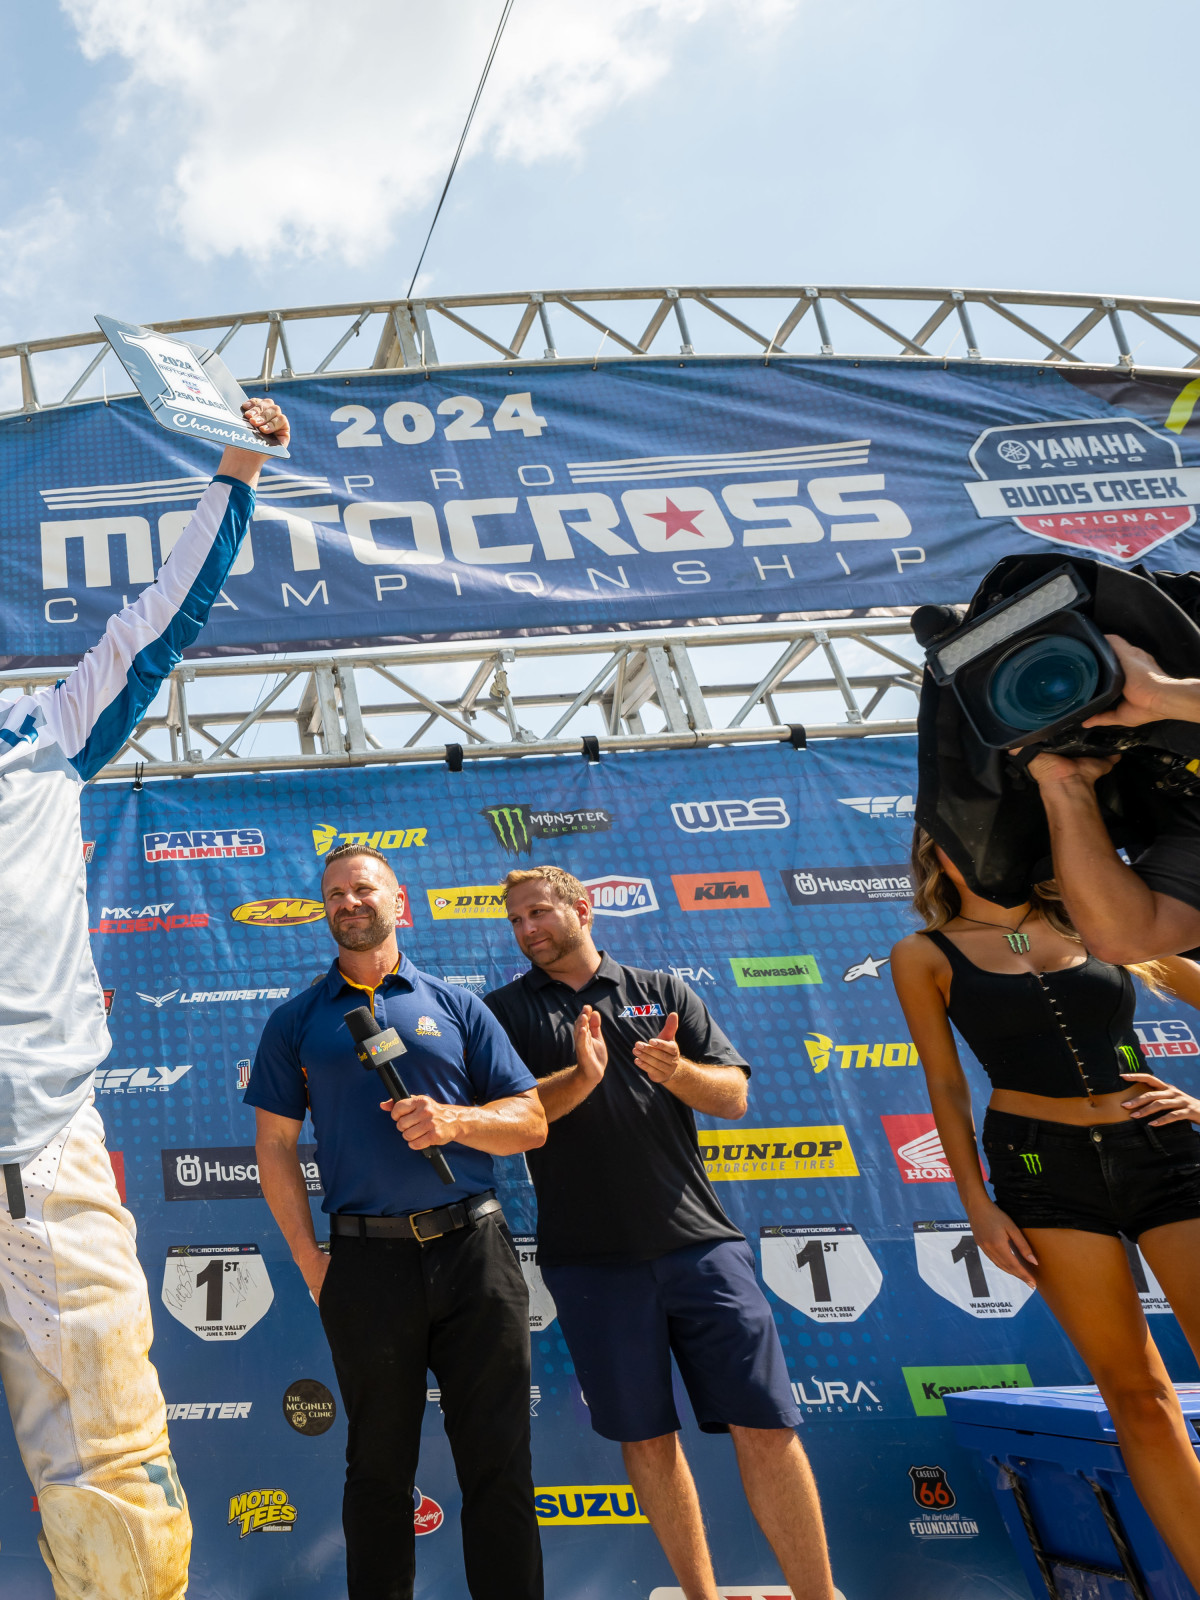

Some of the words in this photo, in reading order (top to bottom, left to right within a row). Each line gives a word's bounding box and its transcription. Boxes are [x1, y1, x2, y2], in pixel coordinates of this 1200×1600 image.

[330, 391, 548, 448] 2024
[173, 413, 270, 448] Champion
[1027, 432, 1147, 460] YAMAHA
[1017, 456, 1144, 471] RACING
[344, 465, 556, 495] PRO
[1000, 482, 1093, 508] BUDDS
[1093, 477, 1187, 502] CREEK
[1038, 511, 1175, 528] NATIONAL
[529, 810, 608, 823] MONSTER
[671, 798, 790, 832] WPS
[543, 824, 597, 832] ENERGY
[145, 829, 263, 851] PARTS
[338, 828, 428, 850] THOR
[146, 845, 265, 862] UNLIMITED
[694, 881, 749, 900] KTM
[817, 875, 910, 892] Husqvarna
[455, 895, 505, 906] DUN
[590, 884, 646, 906] 100%
[868, 891, 915, 899] MOTORCYCLES
[101, 907, 132, 919] MX
[139, 903, 174, 917] ATV
[234, 901, 325, 921] FMF
[454, 906, 507, 914] MOTORCYC
[741, 965, 809, 978] Kawasaki
[179, 987, 291, 1004] LANDMASTER
[618, 1003, 665, 1018] AMA
[380, 1037, 400, 1052] Sports
[100, 1086, 170, 1095] RACING
[700, 1141, 842, 1161] DUNLOP
[707, 1161, 786, 1173] OTORCYCLE
[795, 1159, 835, 1170] TIRES
[905, 1168, 954, 1179] HON
[166, 1402, 252, 1420] ASTER
[916, 1470, 939, 1478] CASELLI
[920, 1482, 949, 1505] 66
[229, 1490, 287, 1522] MOTO
[535, 1492, 645, 1518] SUZU
[240, 1505, 296, 1535] TEES
[414, 1510, 442, 1527] Racing
[909, 1521, 979, 1534] FOUNDATION
